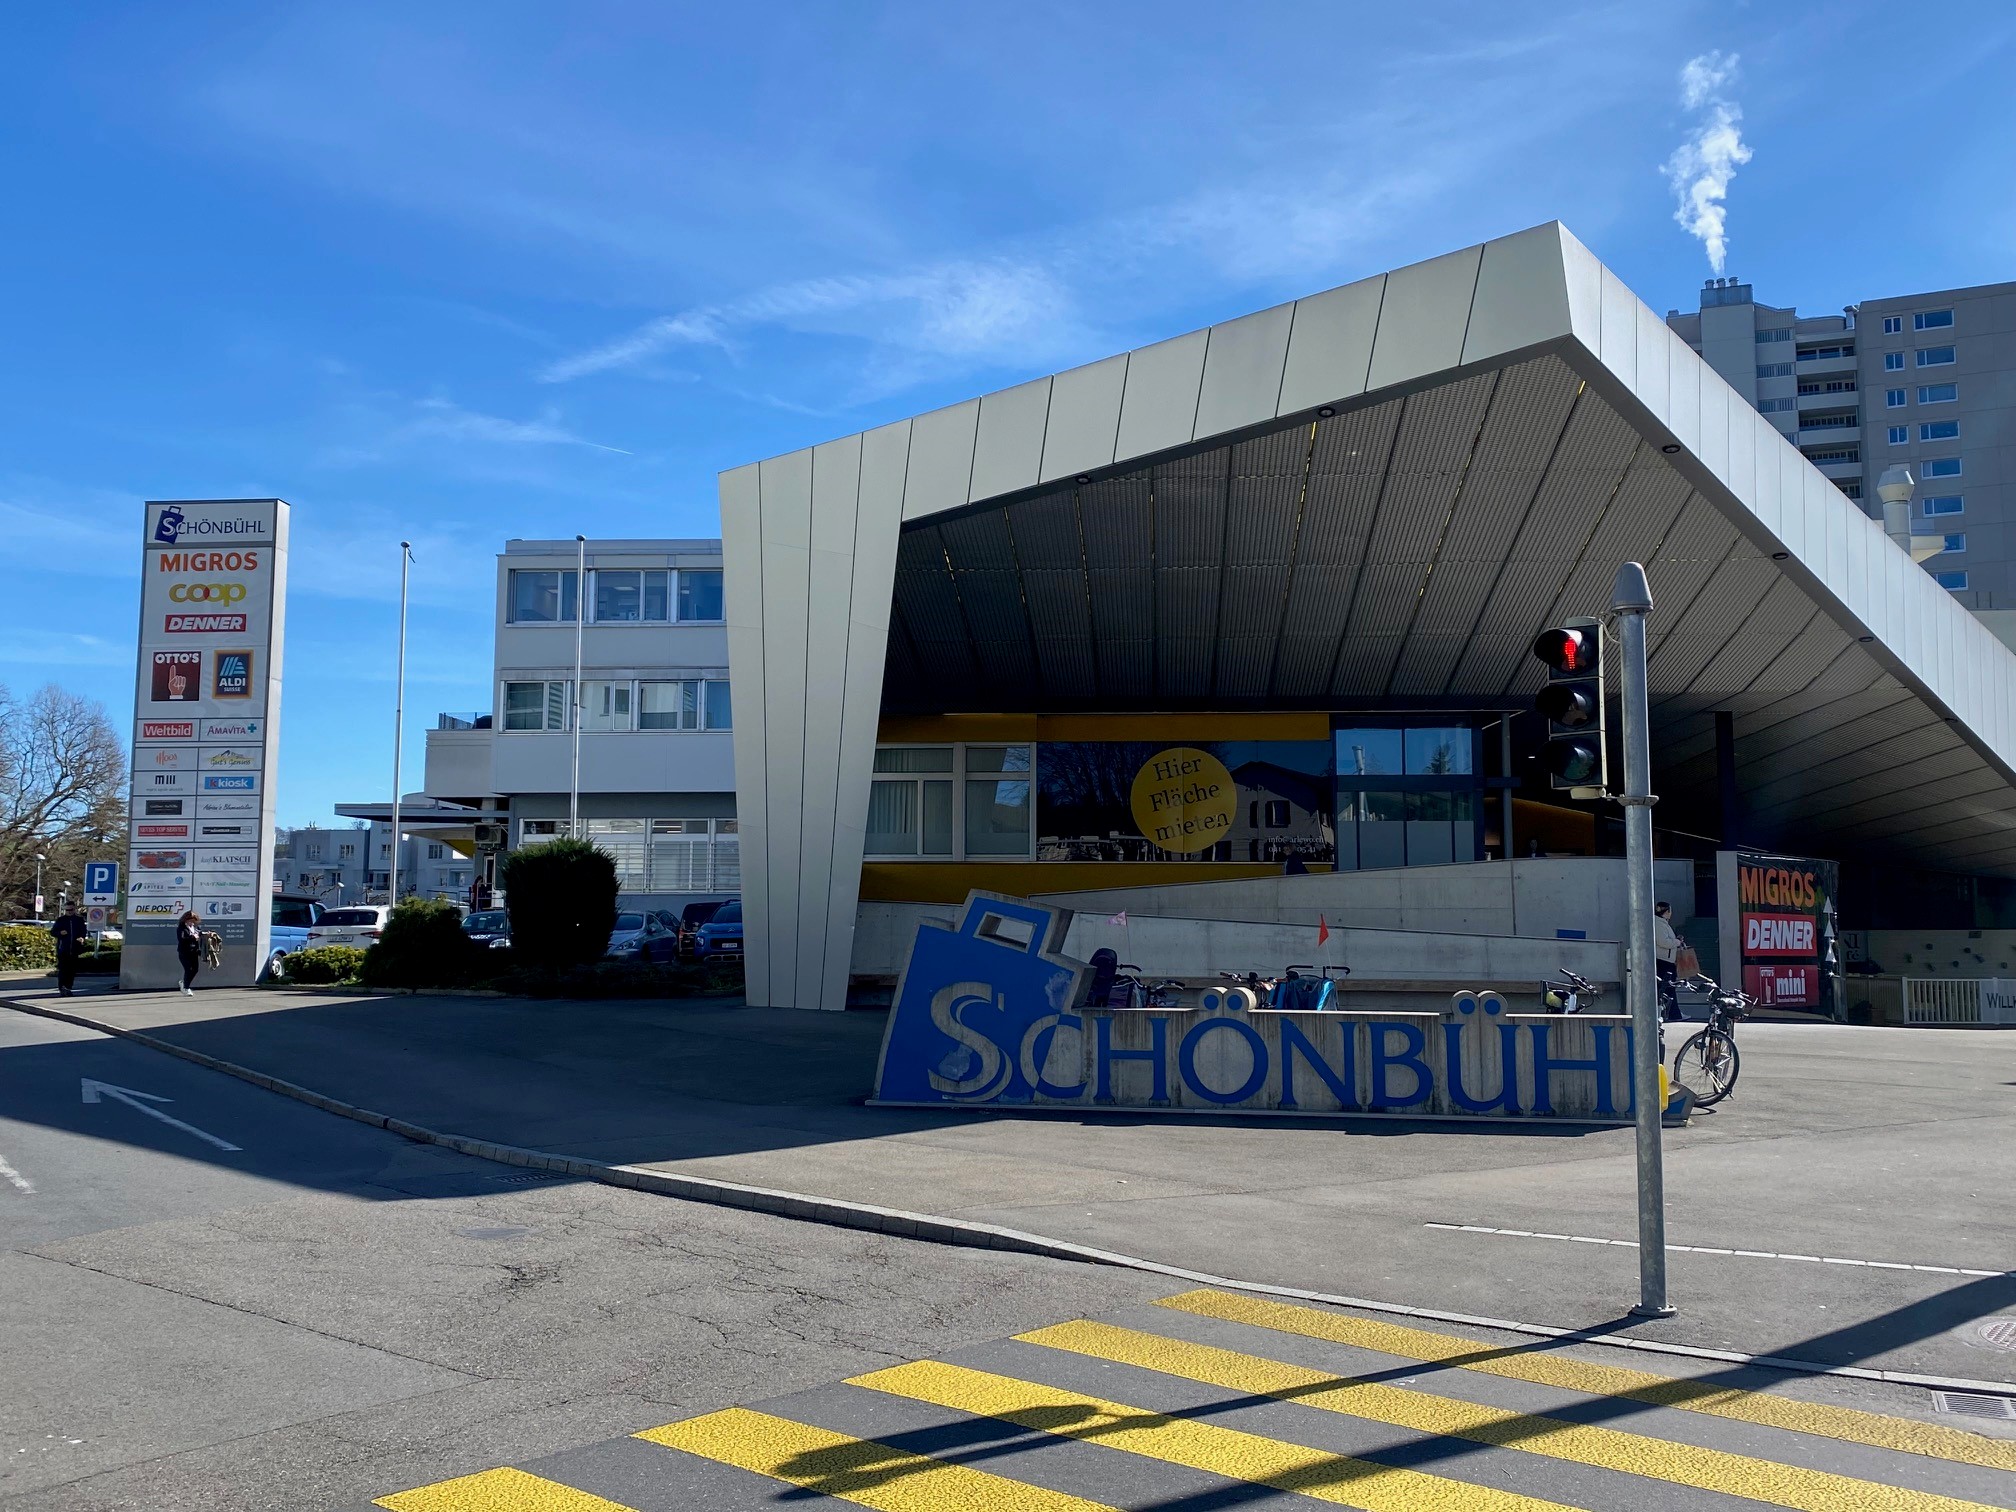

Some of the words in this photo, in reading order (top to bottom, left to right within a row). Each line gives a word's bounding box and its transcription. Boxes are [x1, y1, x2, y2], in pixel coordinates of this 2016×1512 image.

[162, 517, 265, 536] SCHÖNBÜHL
[160, 552, 258, 572] MIGROS
[169, 583, 247, 607] coop
[168, 616, 243, 630] DENNER
[154, 652, 199, 664] OTTO'S
[219, 678, 246, 687] ALDI
[144, 724, 191, 737] Weltbild
[1152, 757, 1203, 783] Hier
[218, 778, 248, 788] kiosk
[1149, 782, 1221, 813] Fläche
[1154, 810, 1230, 842] mieten
[212, 855, 251, 863] KLATSCH
[93, 867, 109, 890] P
[1740, 866, 1816, 908] MIGROS
[135, 904, 150, 913] DIE
[151, 904, 173, 913] POST
[1747, 919, 1814, 950] DENNER
[1776, 968, 1806, 996] mini
